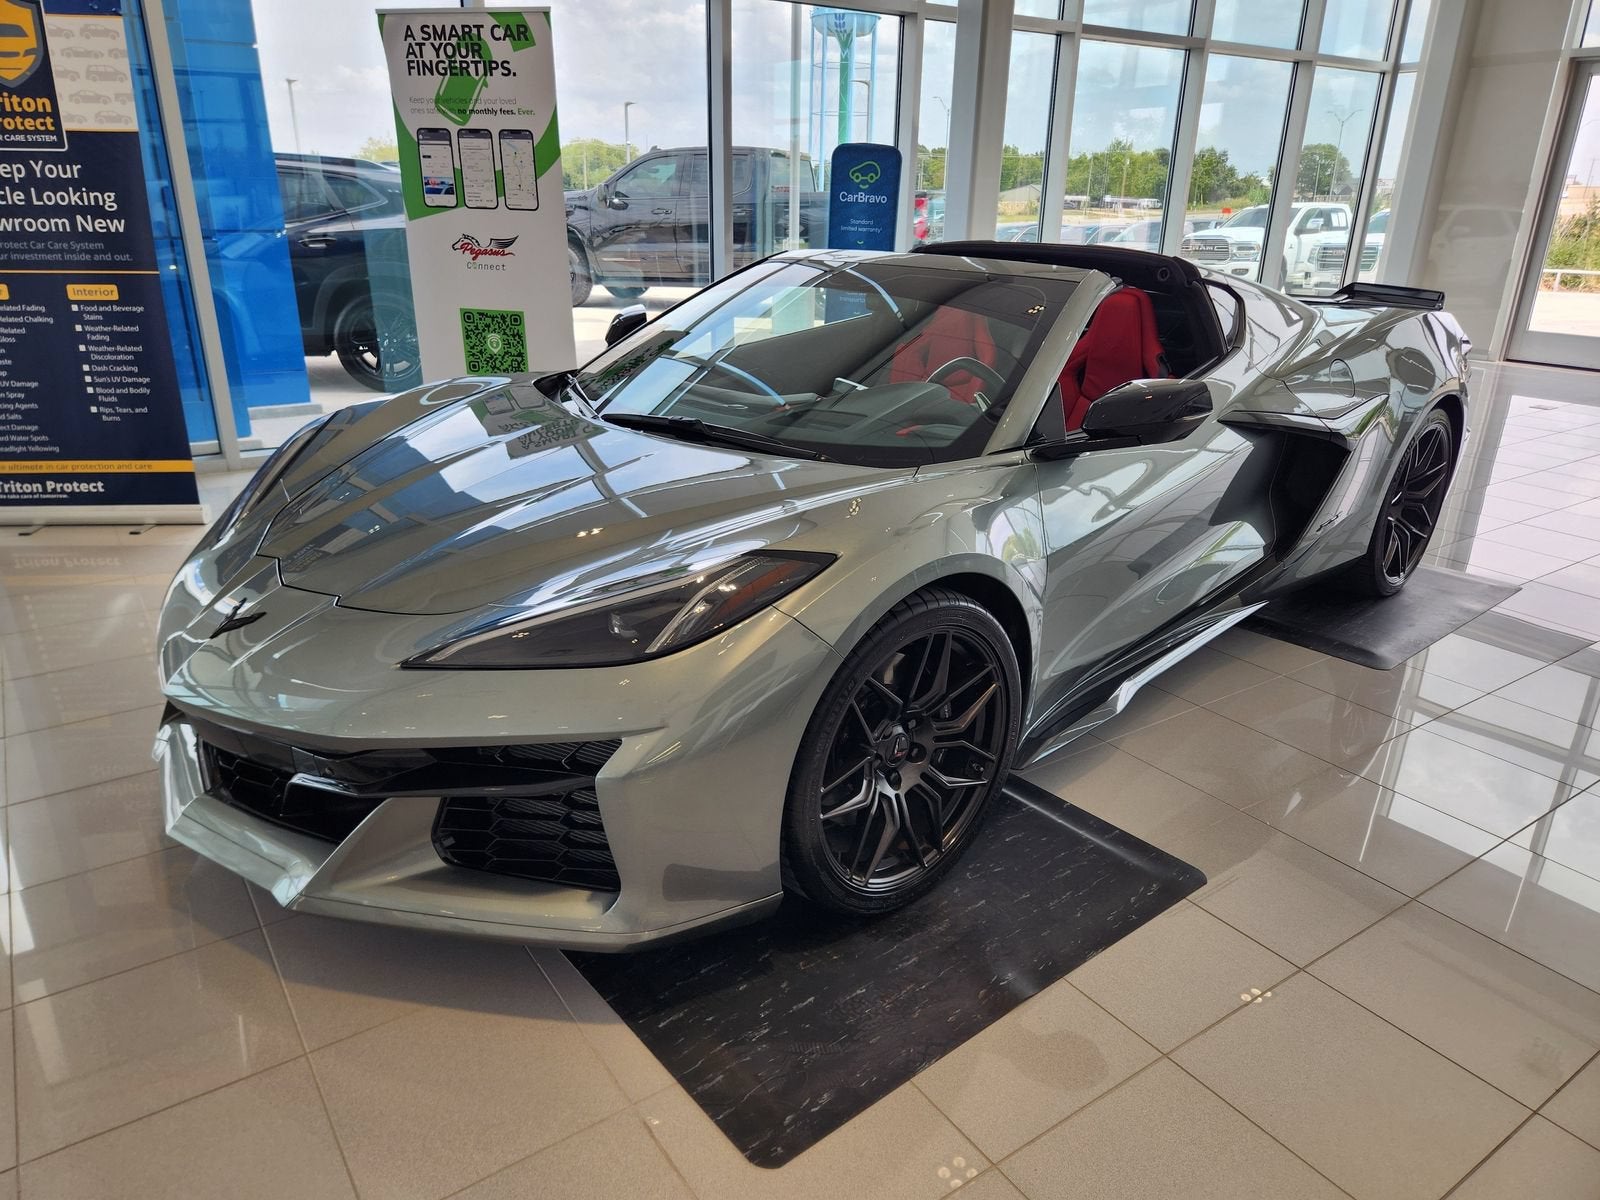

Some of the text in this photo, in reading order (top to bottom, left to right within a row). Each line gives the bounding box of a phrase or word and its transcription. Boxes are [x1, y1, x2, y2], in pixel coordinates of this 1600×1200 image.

[404, 24, 530, 41] A SMART CAR
[406, 42, 484, 59] AT YOUR
[407, 59, 517, 77] FINGERTIPS.
[0, 91, 52, 113] iton
[483, 97, 498, 105] your
[499, 96, 517, 104] loved
[468, 107, 498, 117] monthly
[499, 107, 516, 116] fees.
[517, 108, 536, 116] Ever.
[4, 134, 26, 142] CARE
[27, 134, 57, 142] SYSTEM
[29, 160, 82, 179] Your
[30, 186, 119, 212] Looking
[839, 191, 888, 204] CarBravo
[76, 214, 125, 233] New
[29, 240, 46, 250] Car
[47, 241, 69, 250] Care
[69, 240, 105, 252] System
[460, 242, 516, 261] Pegasus
[10, 252, 63, 261] investment
[64, 252, 91, 261] inside
[93, 252, 112, 261] and
[114, 253, 134, 261] out.
[466, 261, 507, 271] Connect
[72, 287, 115, 297] Interior
[22, 304, 46, 313] Fading
[80, 304, 145, 314] Food and Beverage
[24, 315, 54, 325] Chalking
[82, 313, 103, 321] Stains
[86, 333, 110, 342] Fading
[90, 353, 135, 361] Discoloration
[91, 364, 139, 373] Dash Cracking
[10, 380, 39, 389] Damage
[121, 376, 151, 384] Damage
[95, 386, 115, 394] Blood
[129, 386, 151, 395] Bodily
[5, 391, 25, 400] Spray
[98, 394, 118, 402] Fluids
[15, 402, 39, 411] Agents
[135, 405, 148, 413] and
[6, 412, 22, 421] Salts
[102, 414, 121, 422] Burns
[11, 423, 39, 432] Damage
[10, 434, 29, 442] Water
[30, 434, 49, 443] Spots
[28, 444, 60, 453] Yellowing
[8, 463, 44, 471] ultimate
[71, 462, 116, 471] protection
[117, 462, 132, 470] and
[46, 481, 105, 493] Protect
